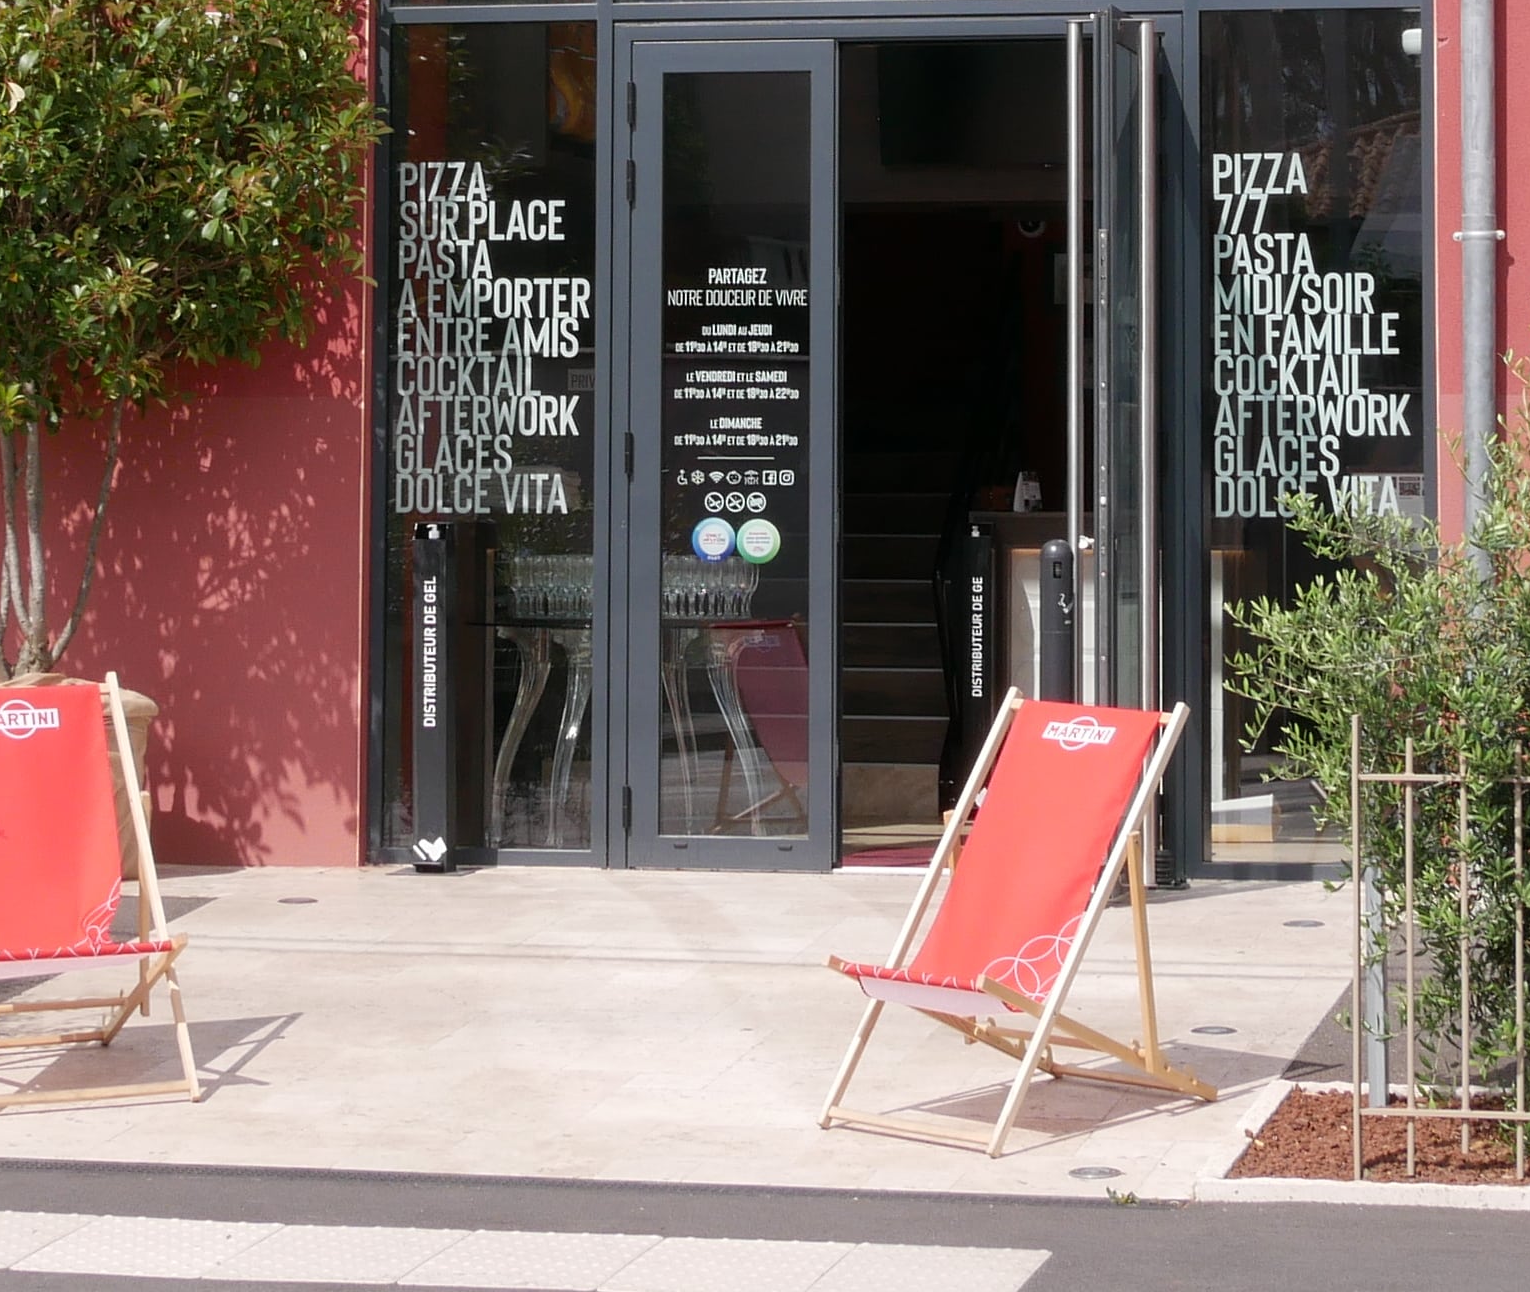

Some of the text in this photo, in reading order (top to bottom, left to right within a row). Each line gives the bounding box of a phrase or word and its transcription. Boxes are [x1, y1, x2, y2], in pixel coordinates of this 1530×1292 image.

[399, 162, 487, 201] PIZZA
[1213, 153, 1308, 195] PIZZA
[399, 199, 565, 241] SUR PLACE
[1213, 193, 1268, 235] 7/7
[398, 239, 493, 279] PASTA
[1214, 233, 1315, 275] PASTA
[709, 268, 767, 284] PARTAGEZ
[1214, 272, 1375, 315] MIDI/SOIR
[427, 277, 591, 319] EMPORTER
[668, 290, 808, 306] NOTRE DOUCEUR DE VIVRE
[397, 317, 580, 358] ENTRE AMIS
[712, 324, 736, 336] LUNDI
[738, 326, 747, 336] AU
[748, 324, 772, 336] JEUDI
[728, 343, 736, 353] ET
[1214, 313, 1400, 355] EN FAMILLE
[397, 355, 541, 397] COCKTAIL
[686, 371, 787, 382] LE VENDREDI ET LE SAMEDI
[727, 389, 735, 399] ET
[1214, 354, 1369, 396] COCKTAIL
[396, 395, 580, 436] AFTERWORK
[710, 417, 762, 429] LE DIMANCHE
[1214, 394, 1411, 437] AFTERWORK
[395, 434, 513, 475] GLACES
[727, 436, 735, 445] ET
[1214, 435, 1340, 477] GLACES
[395, 473, 568, 514] DOLCE VITA
[972, 595, 983, 611] DE
[423, 576, 436, 727] DISTRIBUTEUR DE GEL
[972, 615, 983, 697] DISTRIBUTEUR
[1047, 724, 1111, 741] MARTINI
